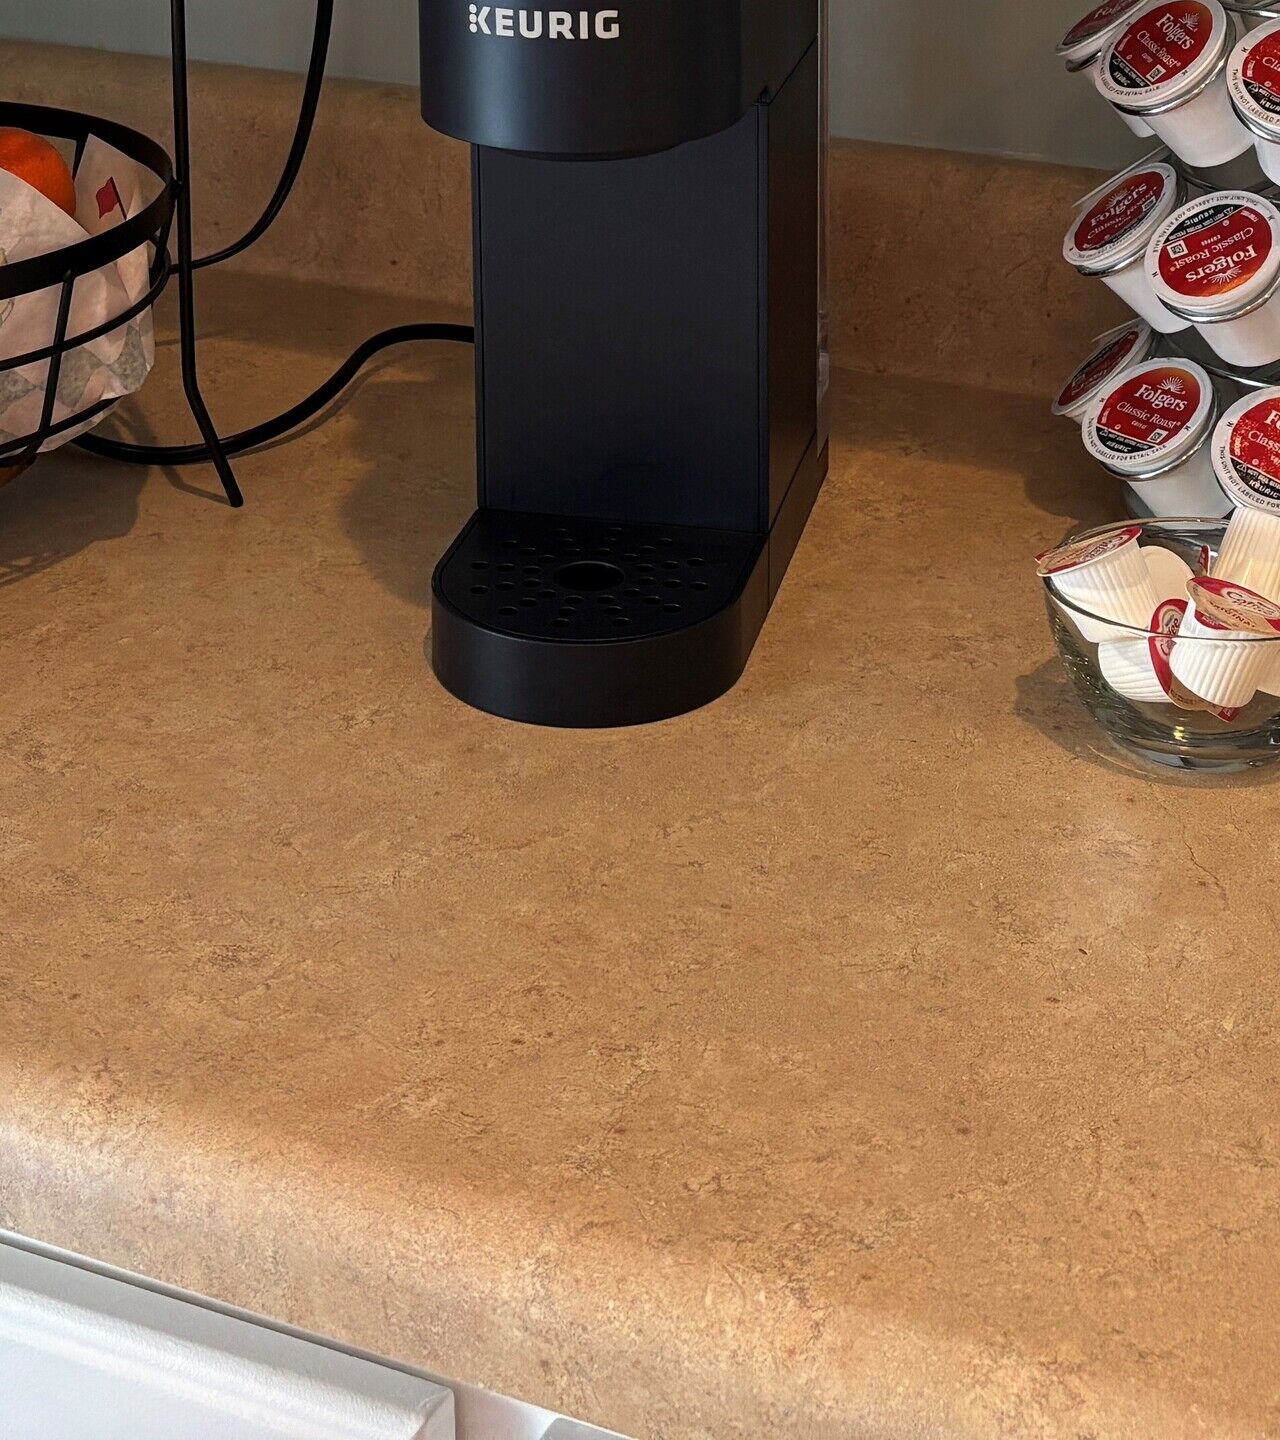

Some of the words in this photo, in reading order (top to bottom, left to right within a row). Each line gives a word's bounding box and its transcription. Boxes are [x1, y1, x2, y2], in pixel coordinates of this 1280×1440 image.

[469, 3, 620, 40] KEURIG
[1156, 13, 1195, 50] Folgers
[1091, 183, 1147, 227] Folgers
[1211, 227, 1254, 253] Classic
[1174, 248, 1211, 269] Roast
[1186, 244, 1258, 282] Folgers
[1133, 384, 1188, 412] Folgers
[1116, 401, 1151, 421] Classic
[1149, 413, 1176, 429] Roast
[1249, 480, 1280, 499] KEURIG
